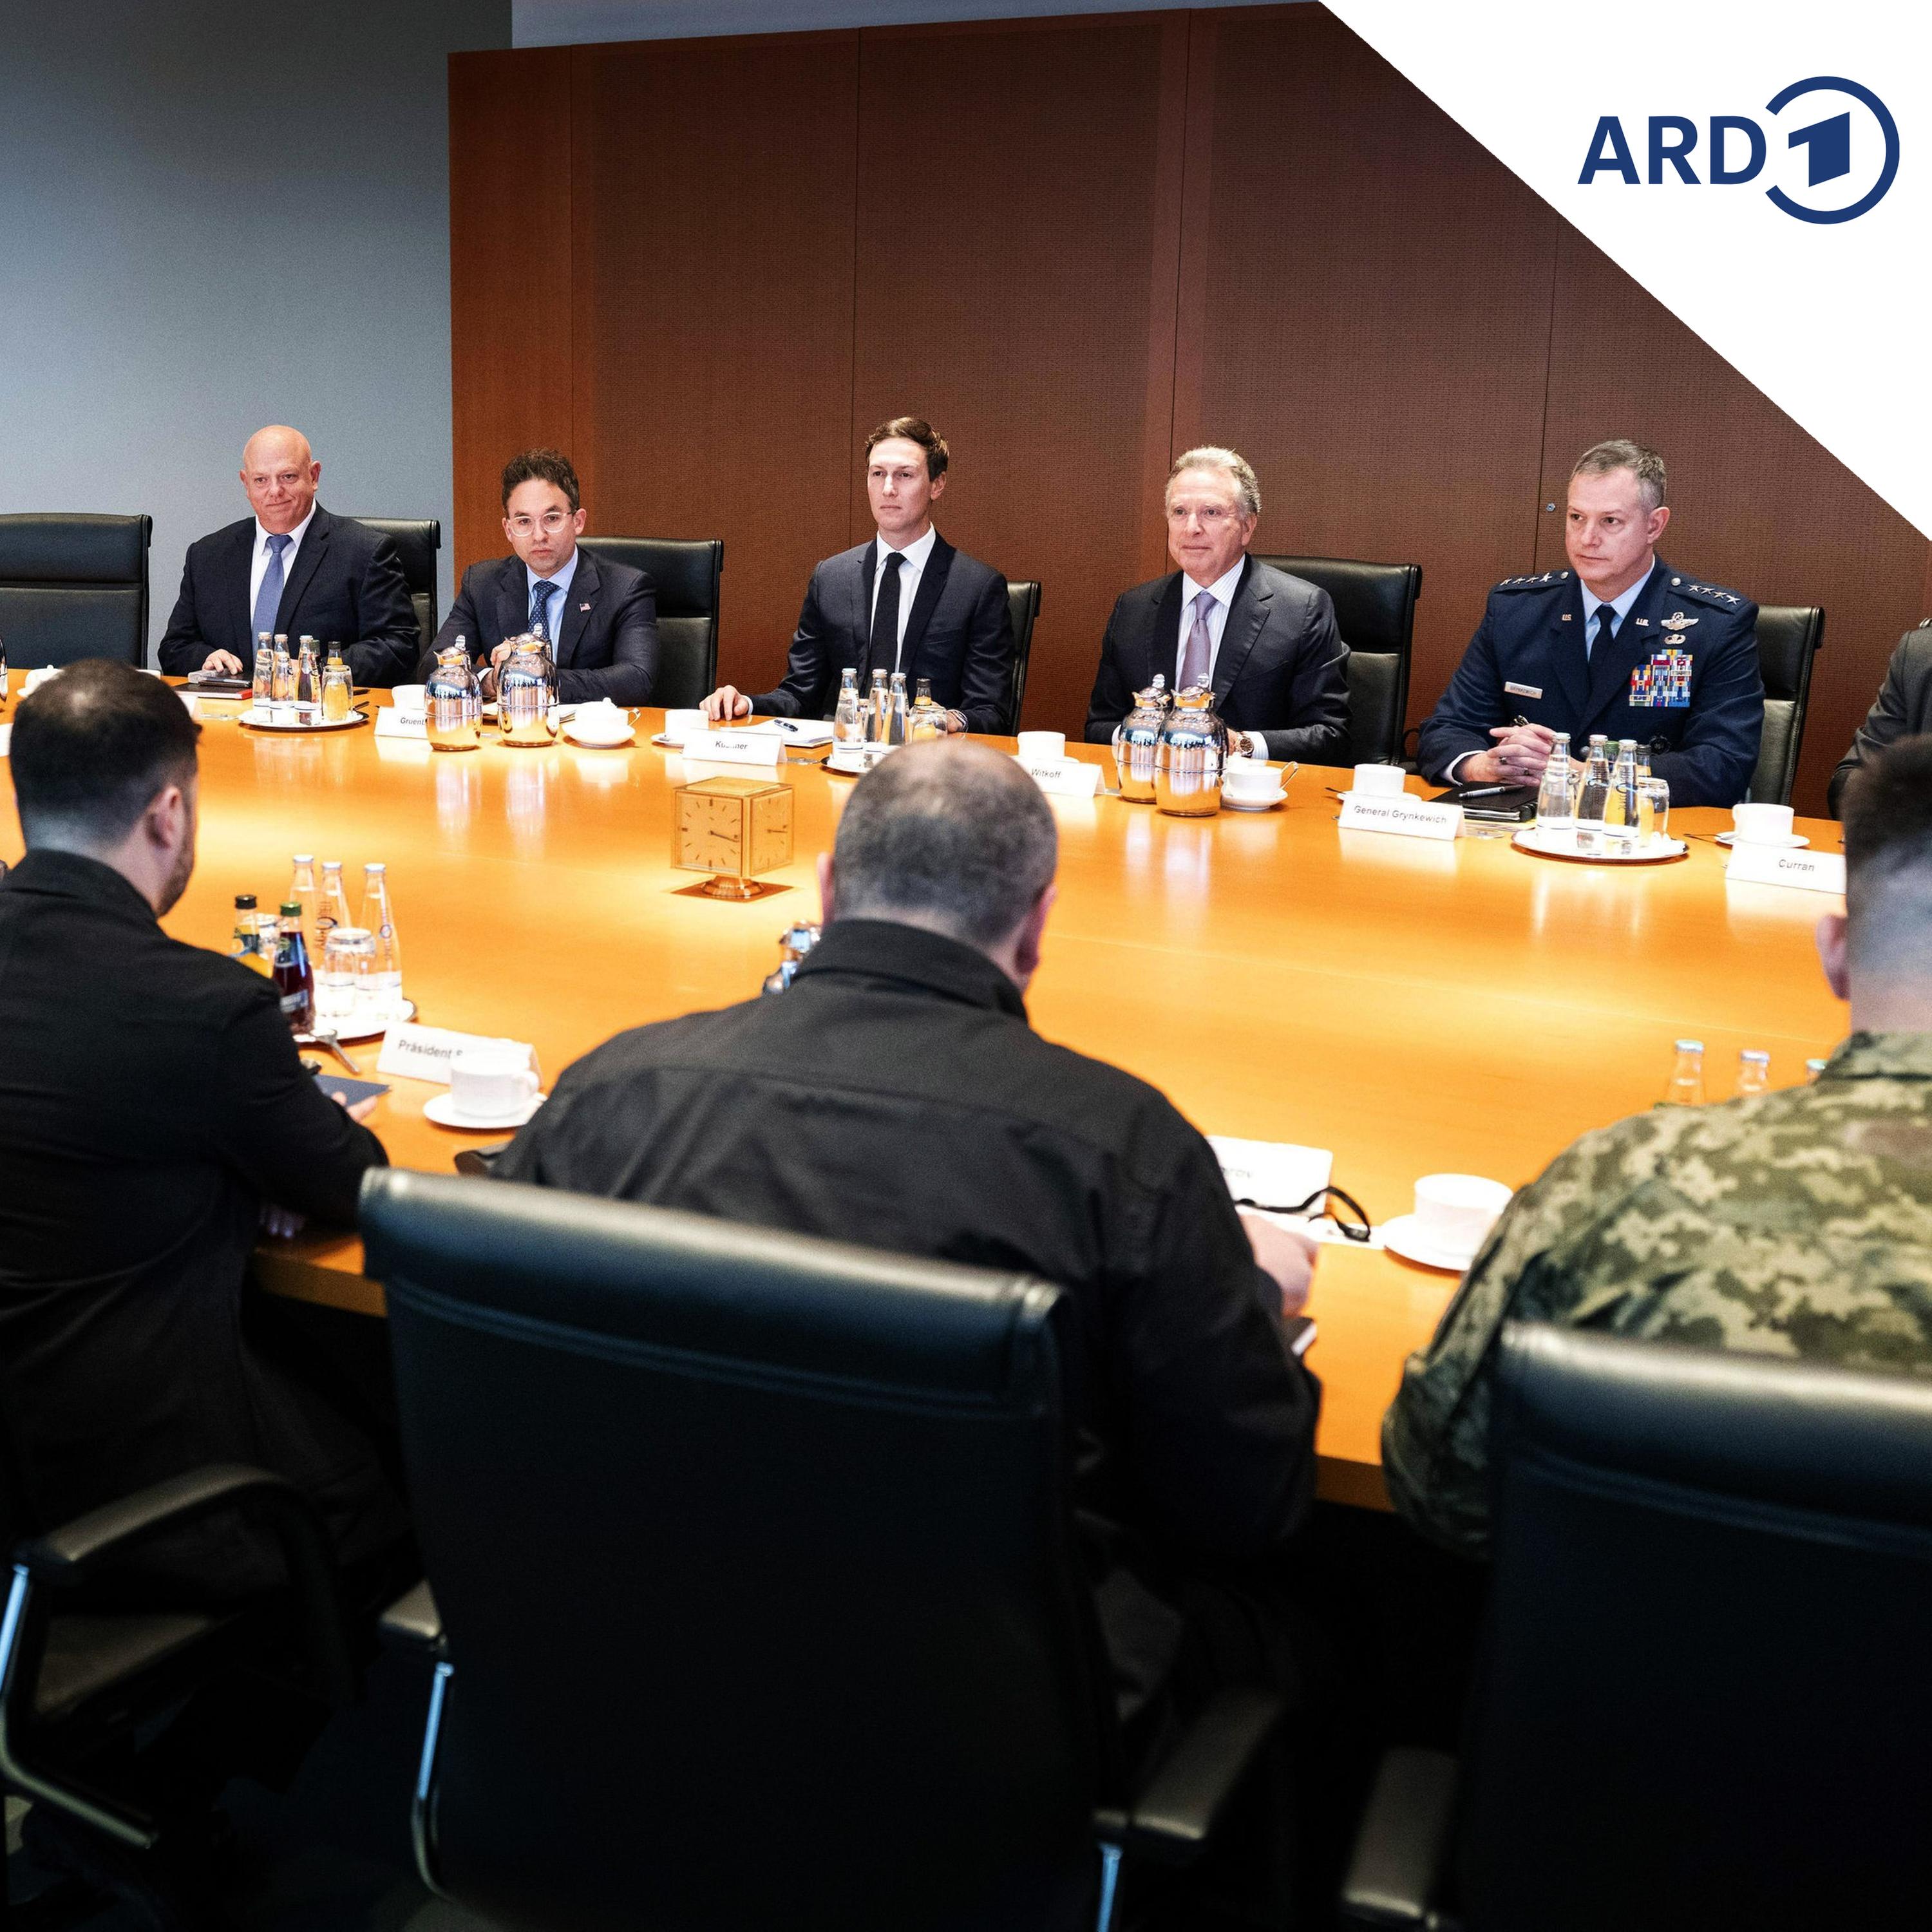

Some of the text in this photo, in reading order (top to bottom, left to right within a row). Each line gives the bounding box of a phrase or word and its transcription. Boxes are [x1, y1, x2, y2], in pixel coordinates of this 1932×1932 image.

[715, 740, 748, 750] Kuner
[1031, 768, 1061, 778] Witkoff
[1354, 805, 1447, 824] General Grynkewich
[1778, 858, 1815, 871] Curran
